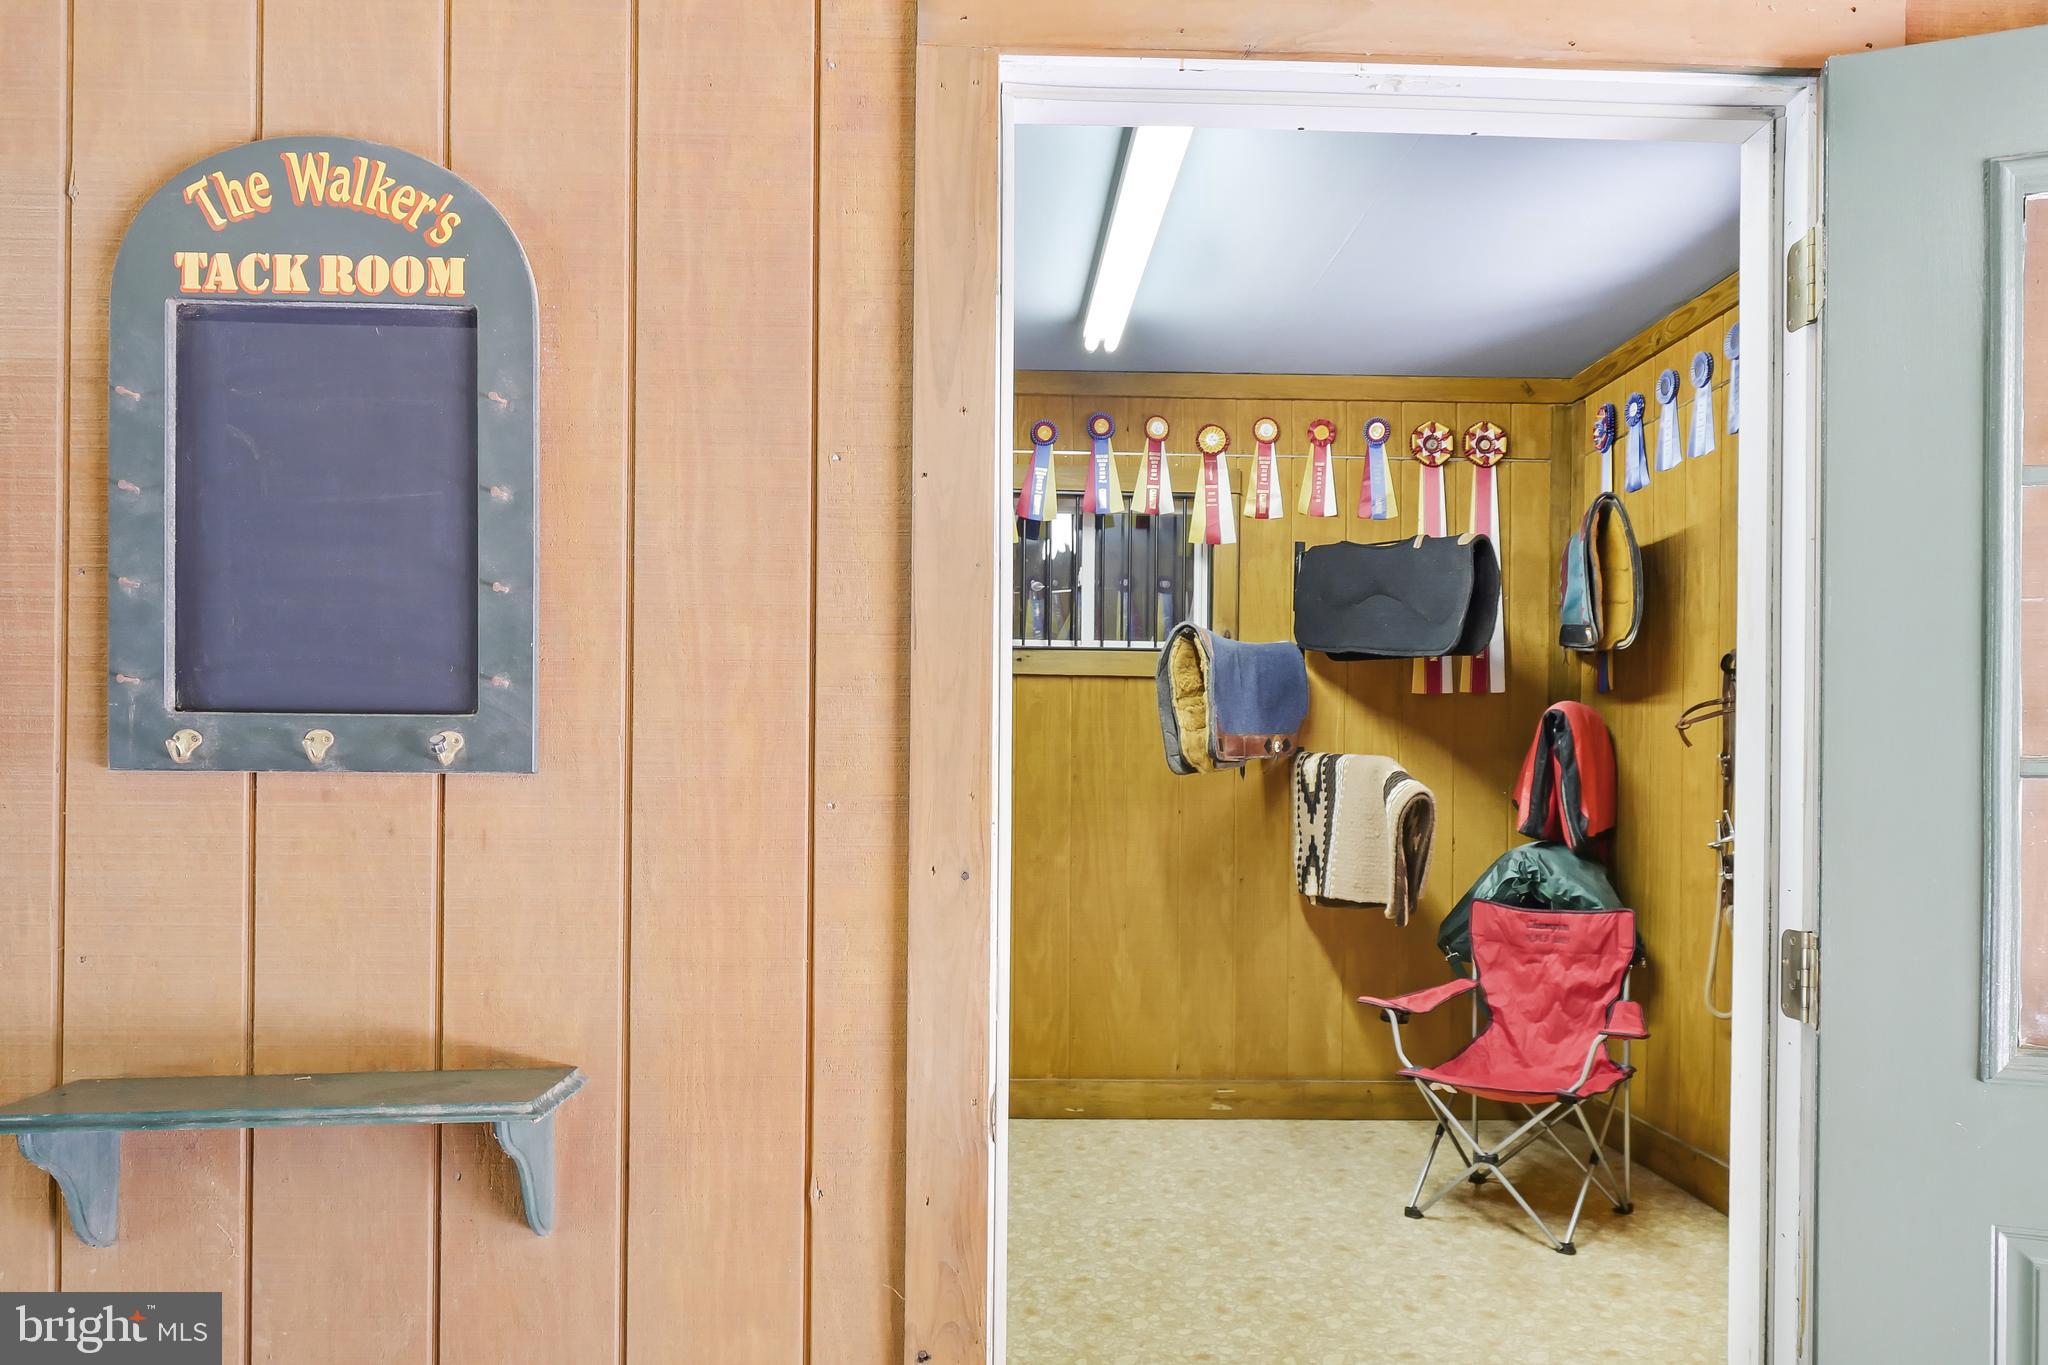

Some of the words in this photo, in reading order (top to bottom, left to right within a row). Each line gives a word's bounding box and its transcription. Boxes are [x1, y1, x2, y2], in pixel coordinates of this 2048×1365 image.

[183, 170, 273, 232] The
[279, 151, 462, 248] Walker's
[174, 251, 310, 294] TACK
[318, 254, 467, 297] ROOM
